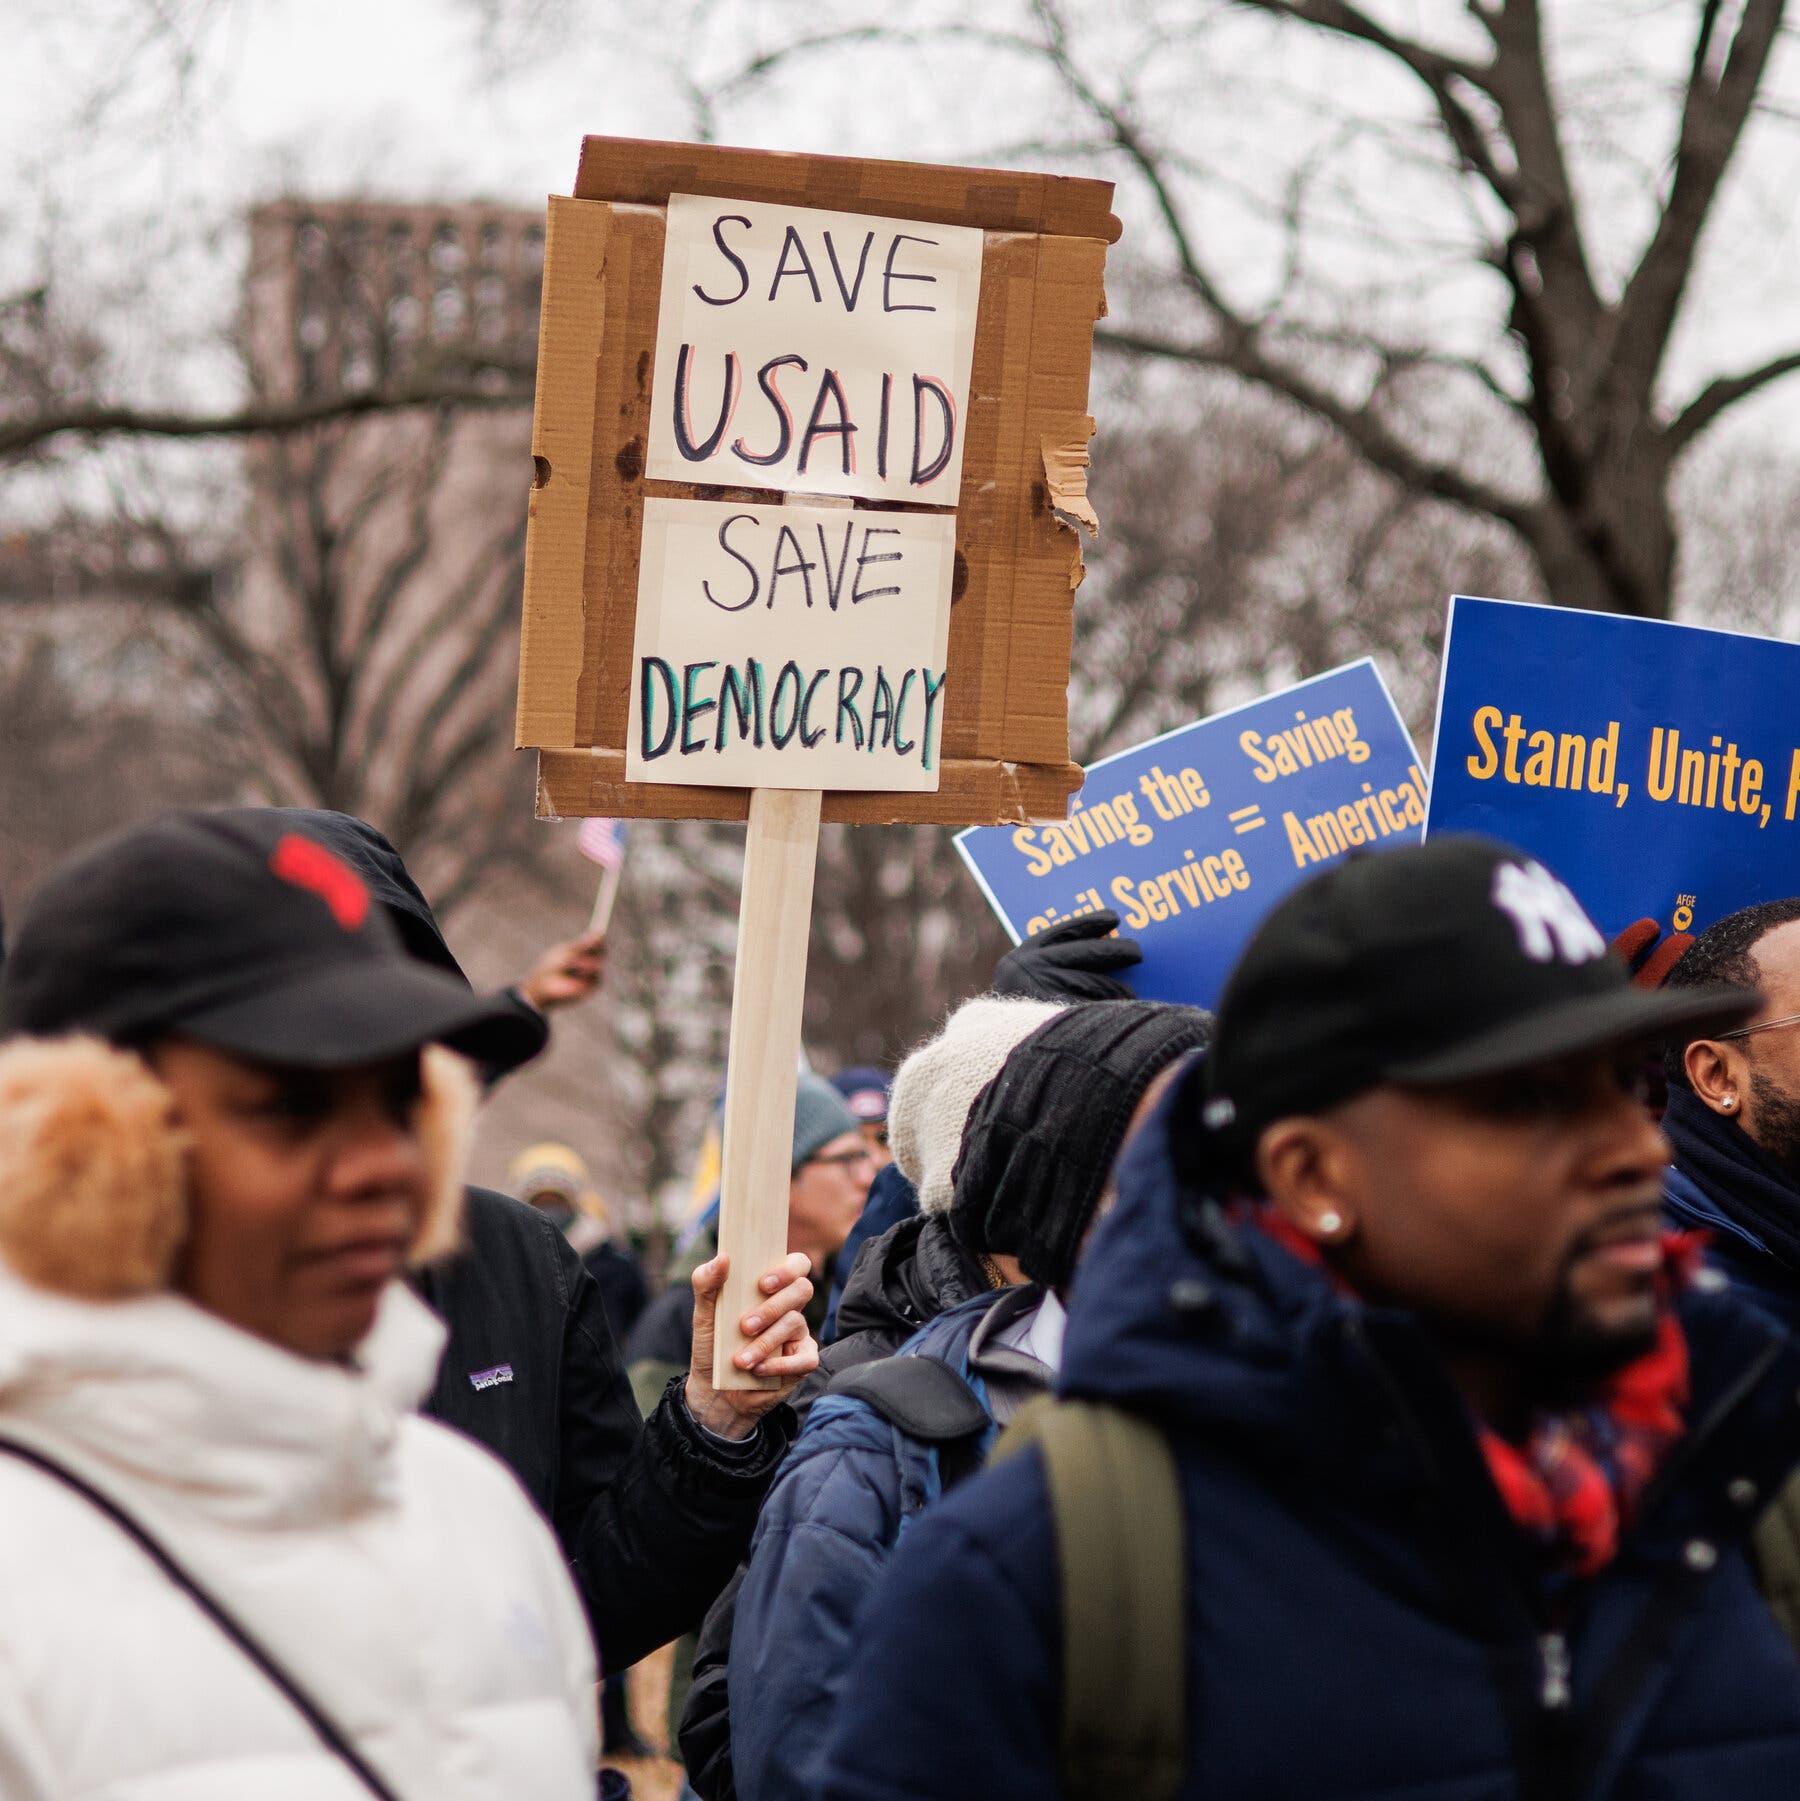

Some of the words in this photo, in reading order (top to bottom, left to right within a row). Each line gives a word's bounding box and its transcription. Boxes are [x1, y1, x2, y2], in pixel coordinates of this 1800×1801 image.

[692, 215, 940, 312] SAVE
[673, 343, 957, 488] USAID
[703, 514, 904, 612] SAVE
[641, 656, 947, 771] DEMOCRACY
[1239, 706, 1371, 783] Saving
[1467, 705, 1630, 808] Stand,
[1648, 726, 1772, 829] Unite,
[1012, 791, 1154, 877] Saving
[1139, 766, 1211, 821] the
[1110, 848, 1251, 930] Service
[1676, 893, 1697, 907] AFGE
